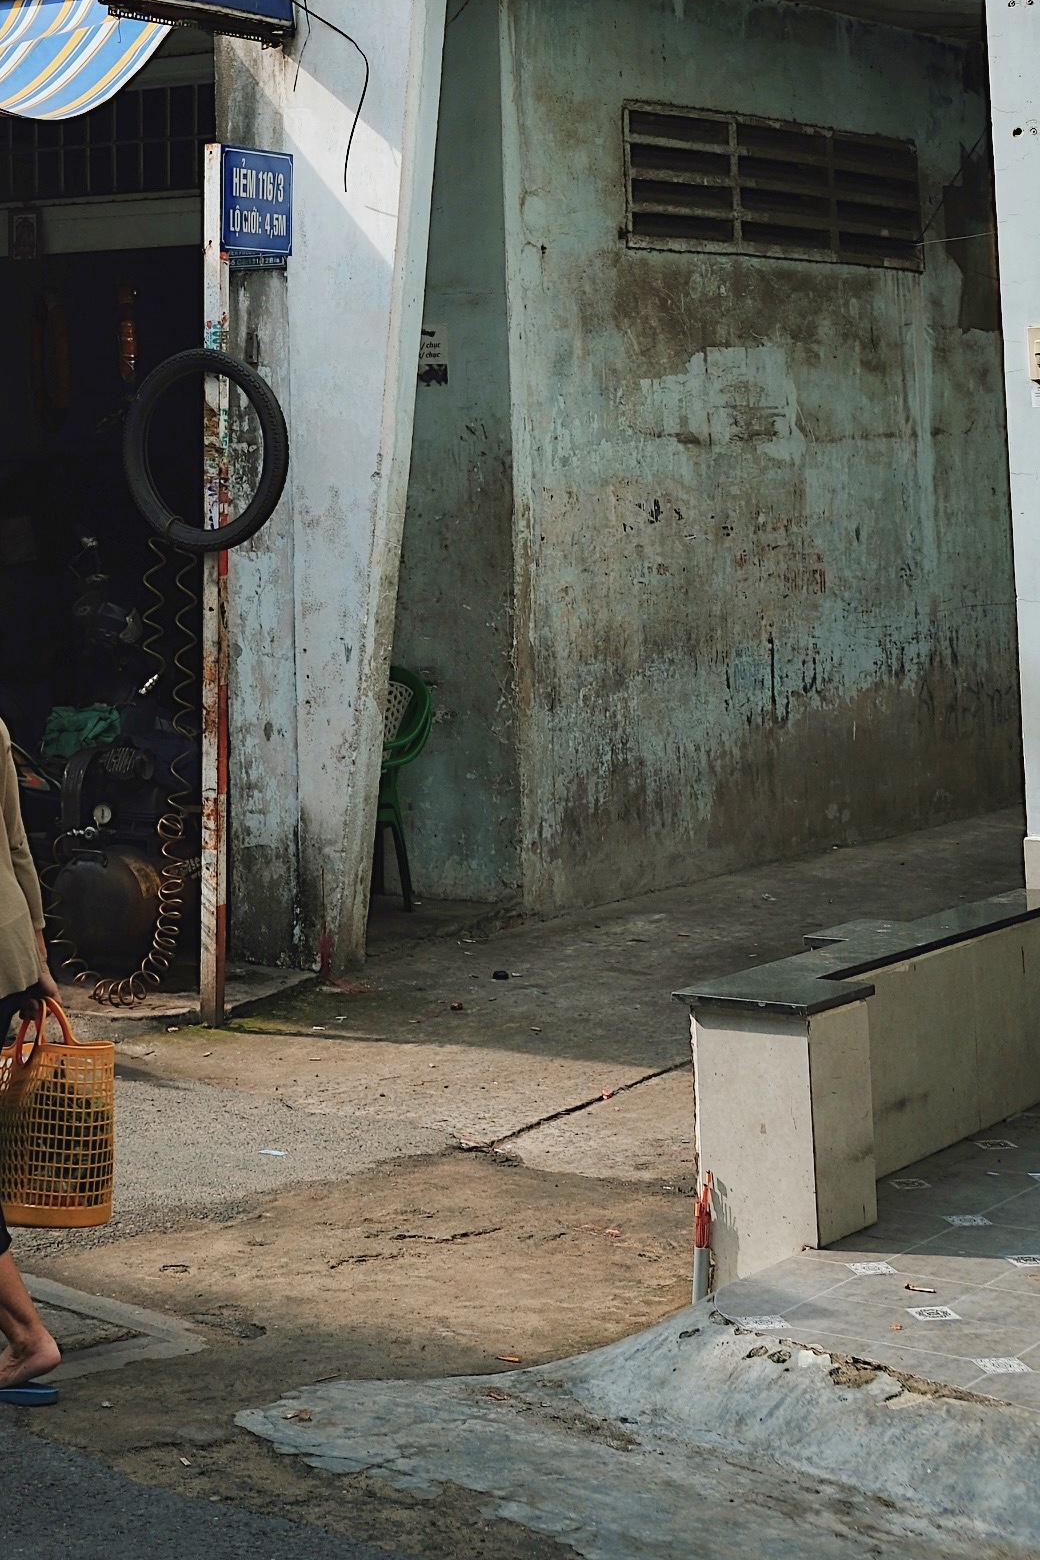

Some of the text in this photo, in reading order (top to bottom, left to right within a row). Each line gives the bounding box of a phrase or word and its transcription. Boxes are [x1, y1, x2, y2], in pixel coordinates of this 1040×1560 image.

[232, 158, 284, 204] HẺM 116/3
[229, 205, 240, 237] LỘ
[264, 213, 287, 239] 4,5M
